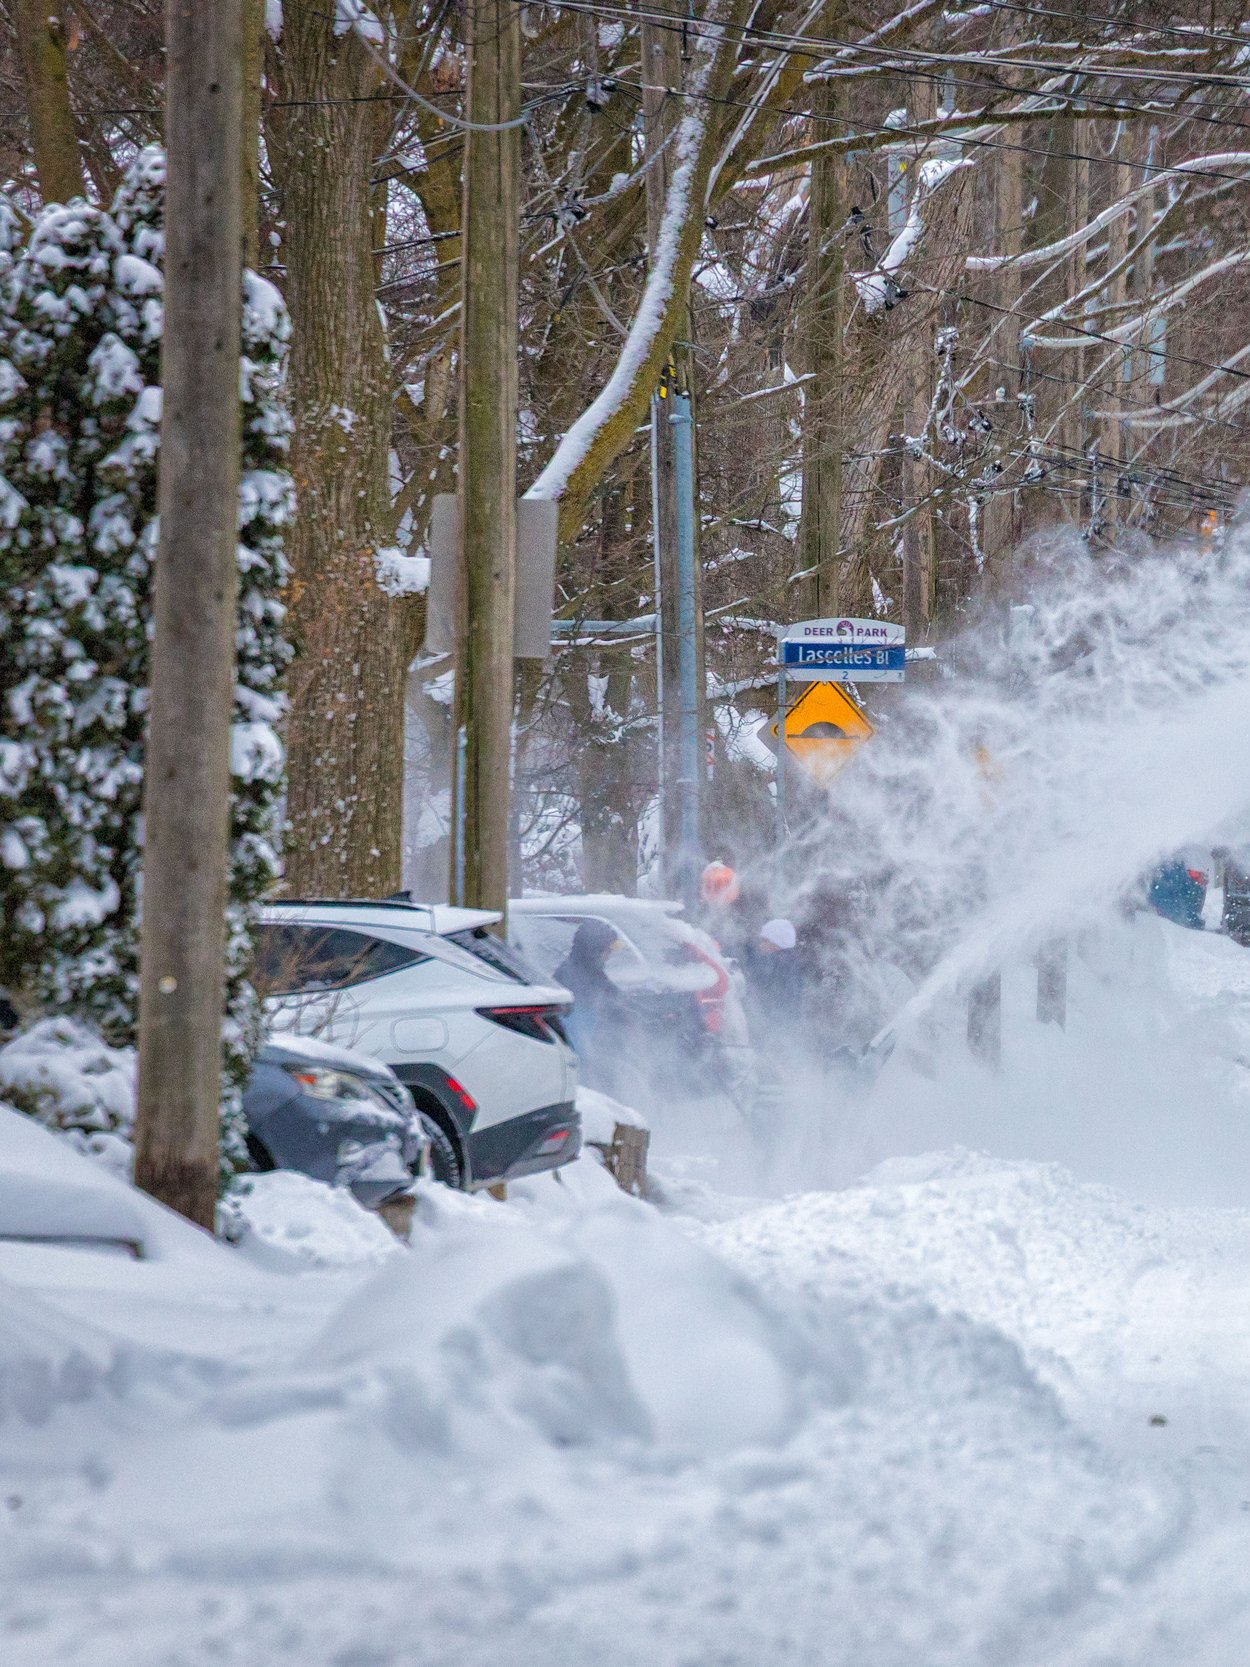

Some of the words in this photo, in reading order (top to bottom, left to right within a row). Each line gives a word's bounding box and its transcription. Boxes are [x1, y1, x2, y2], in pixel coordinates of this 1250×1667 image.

[804, 627, 834, 637] DEER
[857, 628, 887, 637] PARK
[799, 646, 872, 665] Lascelles
